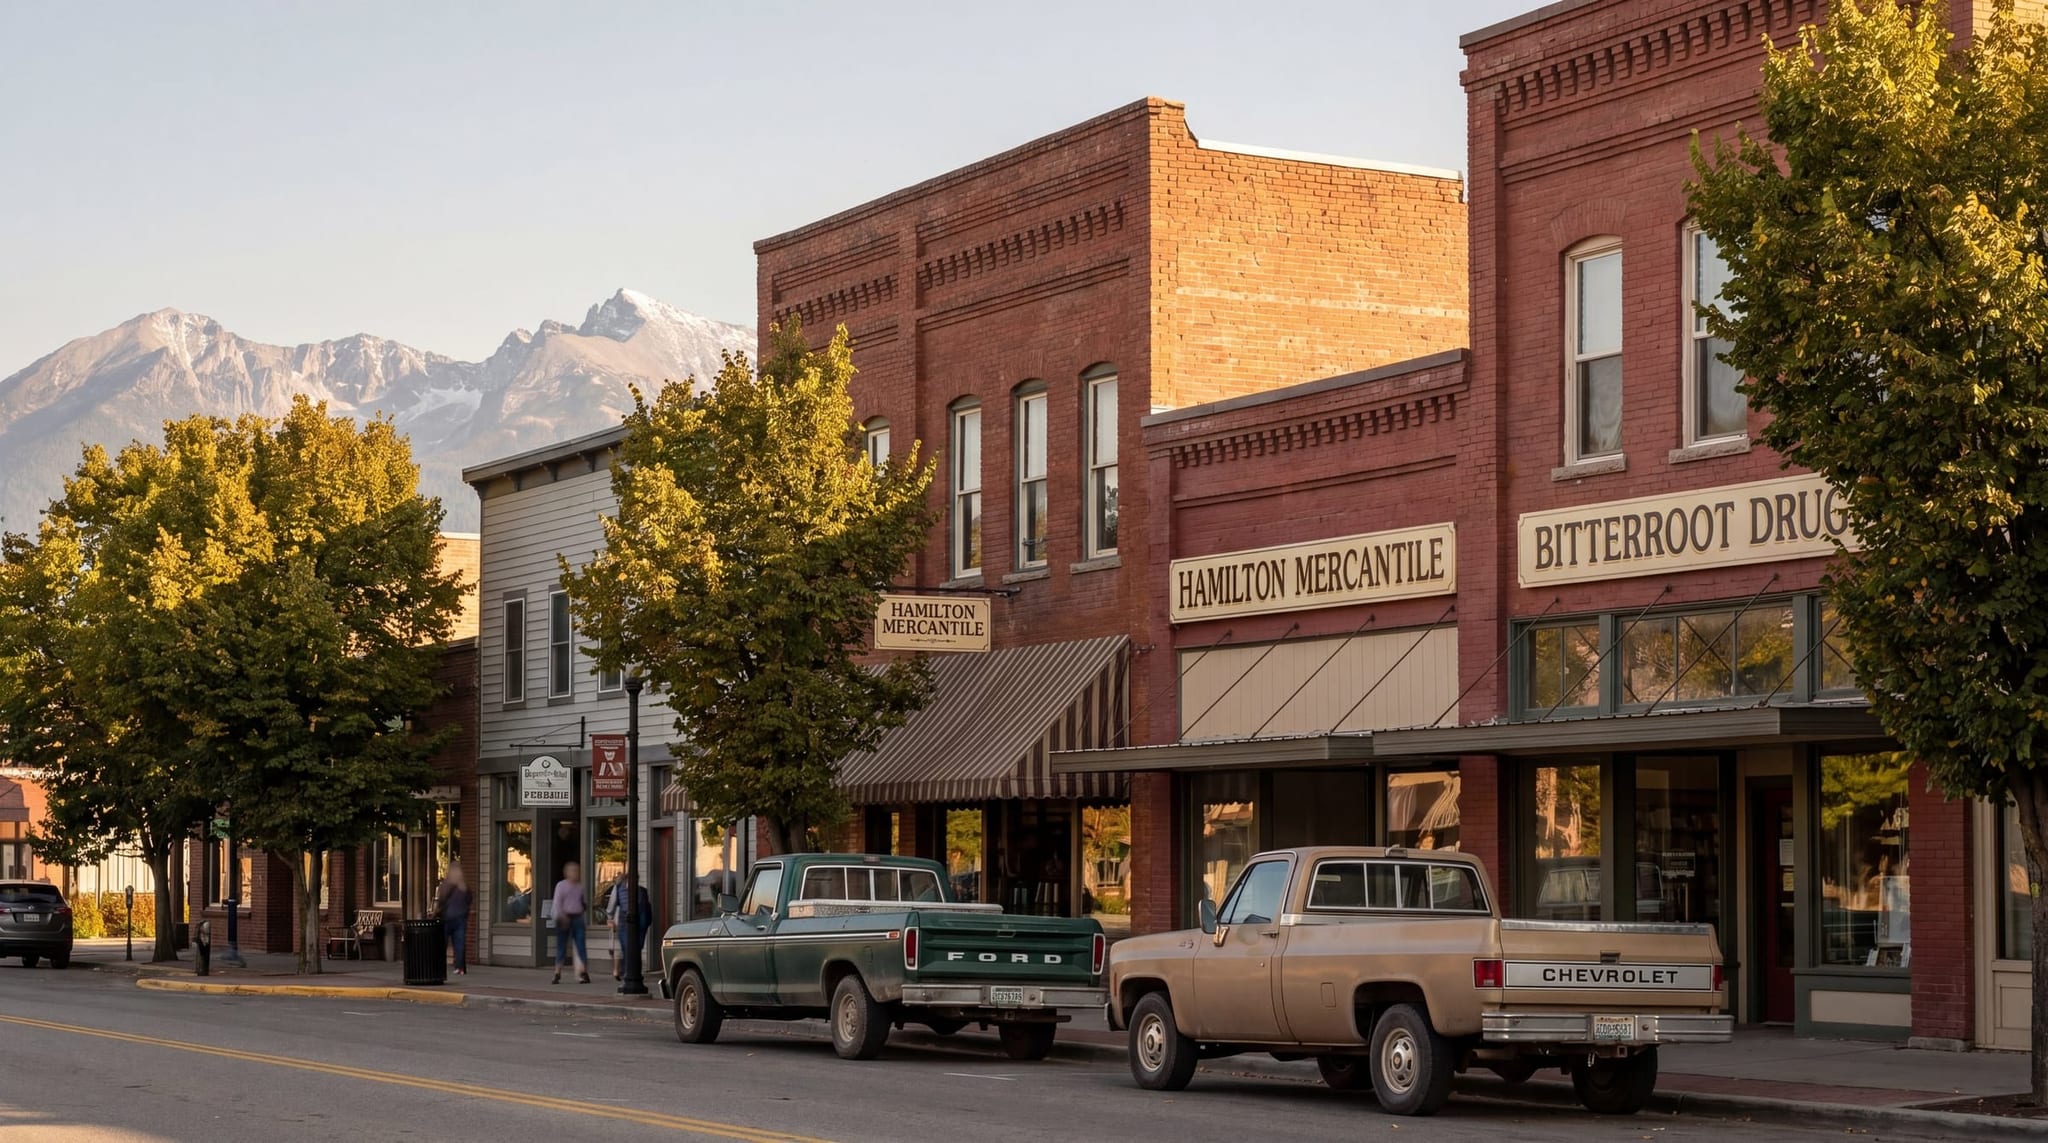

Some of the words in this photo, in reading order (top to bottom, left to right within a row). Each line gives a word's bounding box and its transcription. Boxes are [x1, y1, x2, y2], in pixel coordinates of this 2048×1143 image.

[1535, 501, 1735, 570] BITTERROOT
[1750, 486, 1848, 545] DRUG
[1179, 559, 1286, 609] HAMILTON
[1295, 537, 1444, 595] MERCANTILE
[891, 602, 975, 619] HAMILTON
[882, 619, 984, 636] MERCANTILE
[947, 952, 1062, 964] FORD
[1543, 968, 1679, 984] CHEVROLET
